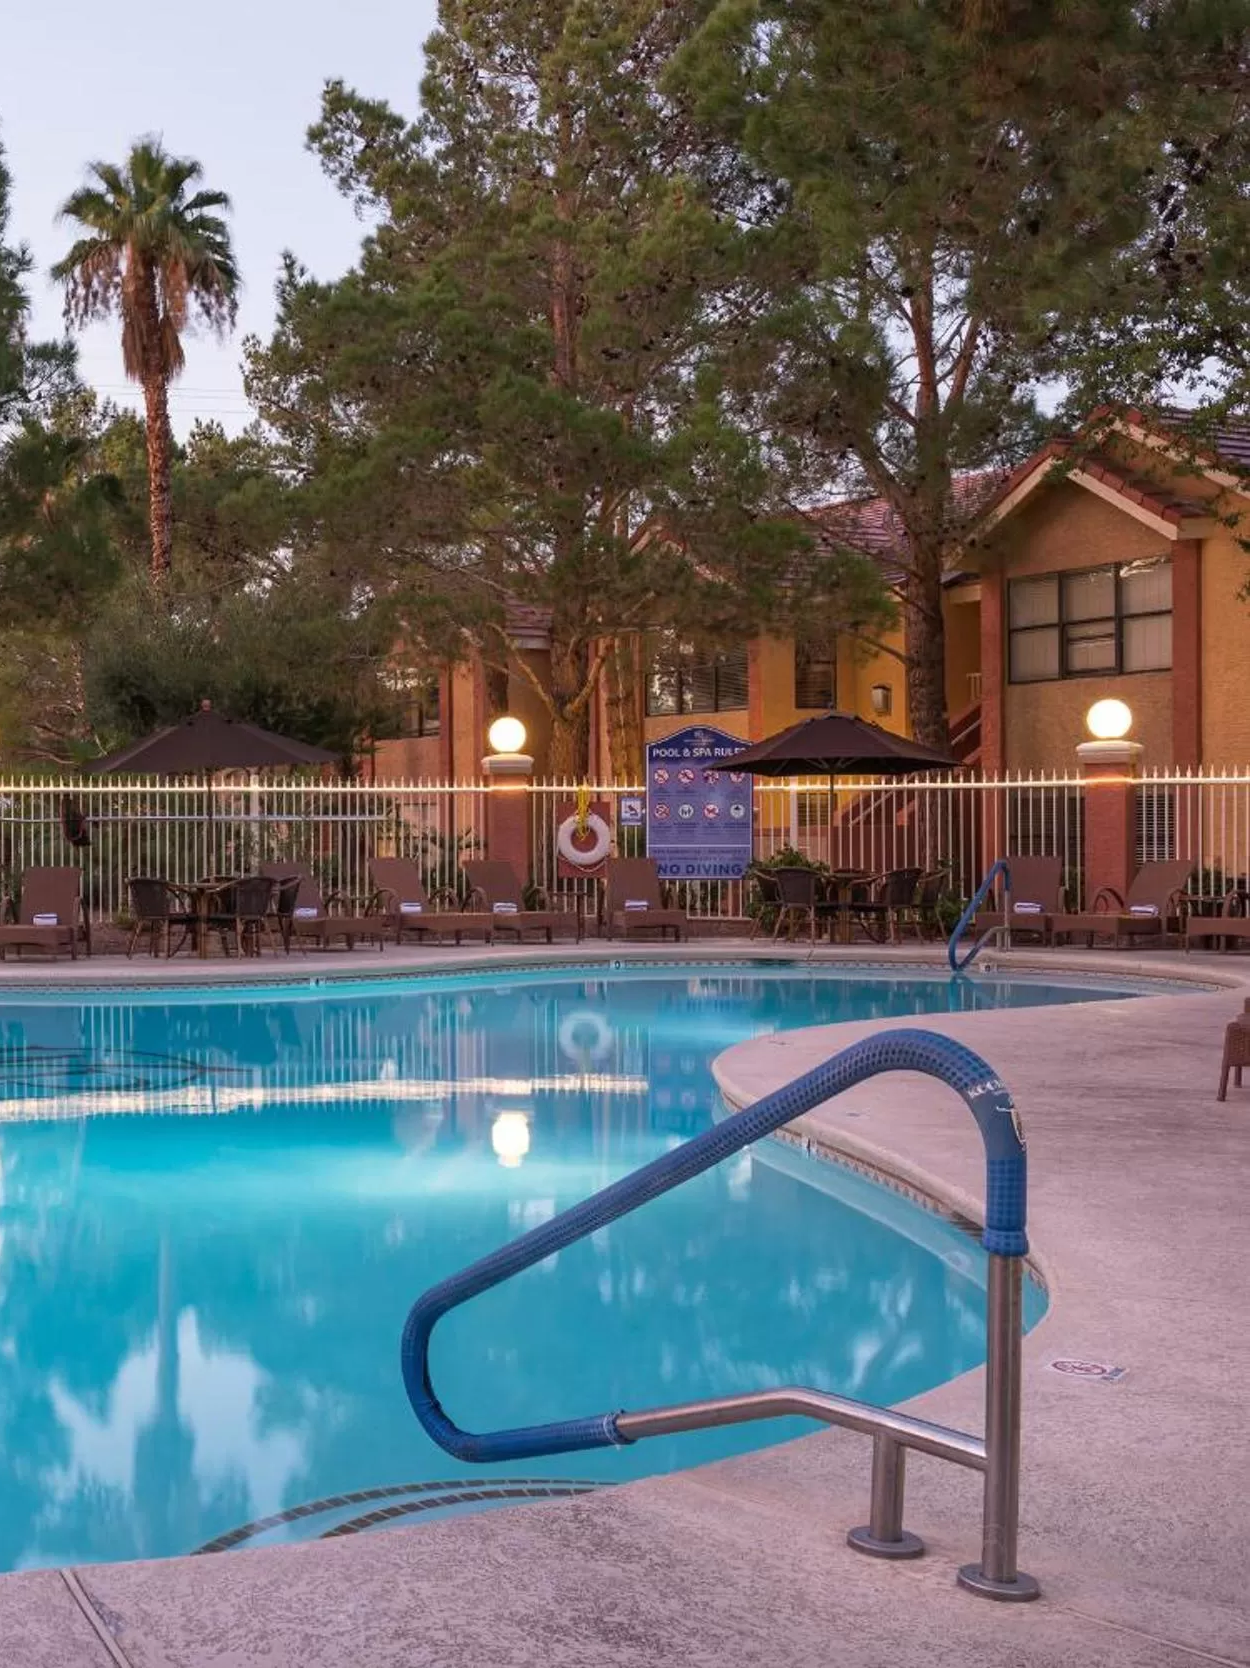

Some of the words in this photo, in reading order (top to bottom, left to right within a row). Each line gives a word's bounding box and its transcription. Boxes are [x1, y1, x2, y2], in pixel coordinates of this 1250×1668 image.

[652, 747, 681, 757] POOL
[682, 747, 691, 757] &
[692, 747, 712, 757] SPA
[714, 747, 746, 757] RULE
[657, 863, 681, 875] NO
[686, 863, 743, 875] DIVING
